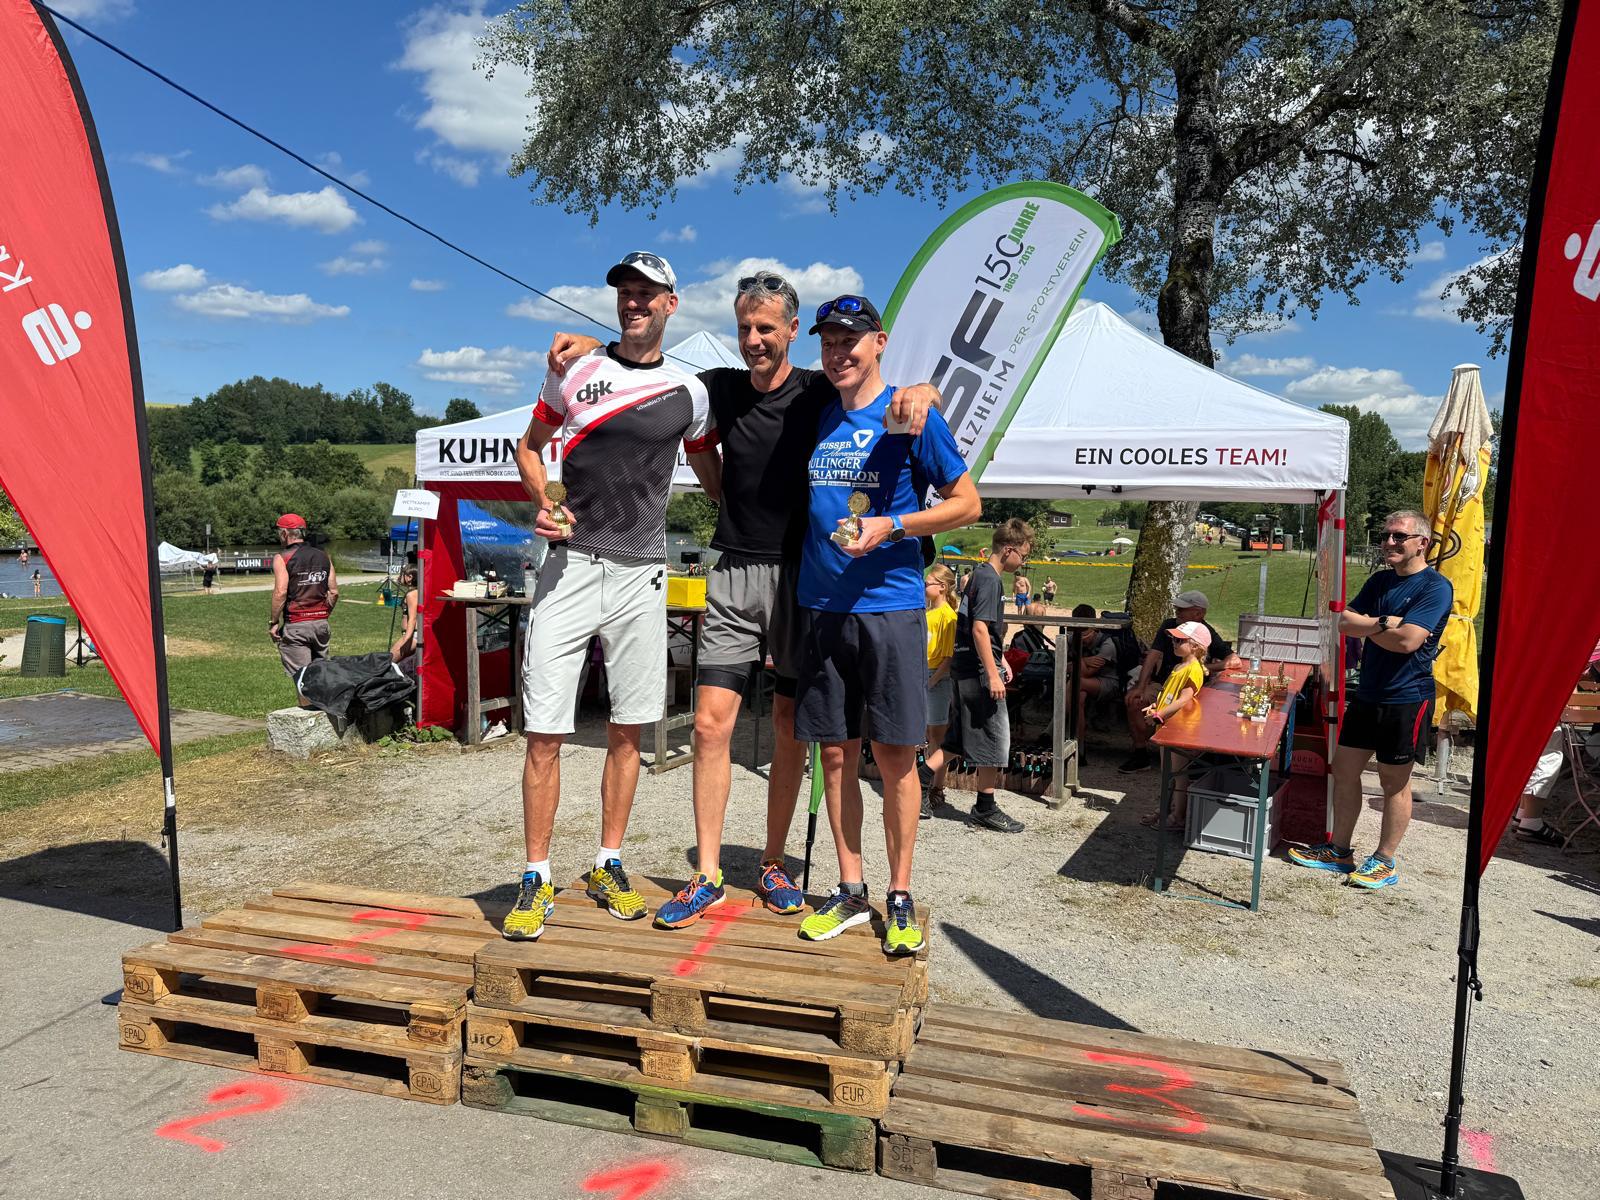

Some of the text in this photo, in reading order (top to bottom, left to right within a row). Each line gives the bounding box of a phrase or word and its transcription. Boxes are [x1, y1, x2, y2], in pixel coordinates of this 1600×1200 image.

[1007, 201, 1041, 245] JAHRE
[959, 228, 1088, 459] ELZHEIM DER SPORTVEREIN
[576, 380, 614, 405] djk
[438, 438, 522, 463] KUHN
[1075, 448, 1288, 466] EIN COOLES TEAM!
[809, 469, 880, 482] TRIATHLON
[237, 559, 272, 568] KUHN IT
[128, 980, 146, 992] EPAL
[124, 1027, 143, 1041] EPAL
[416, 1075, 437, 1090] EPAL
[842, 1086, 865, 1102] EUR
[1071, 1052, 1211, 1134] 3
[154, 1081, 289, 1153] 2
